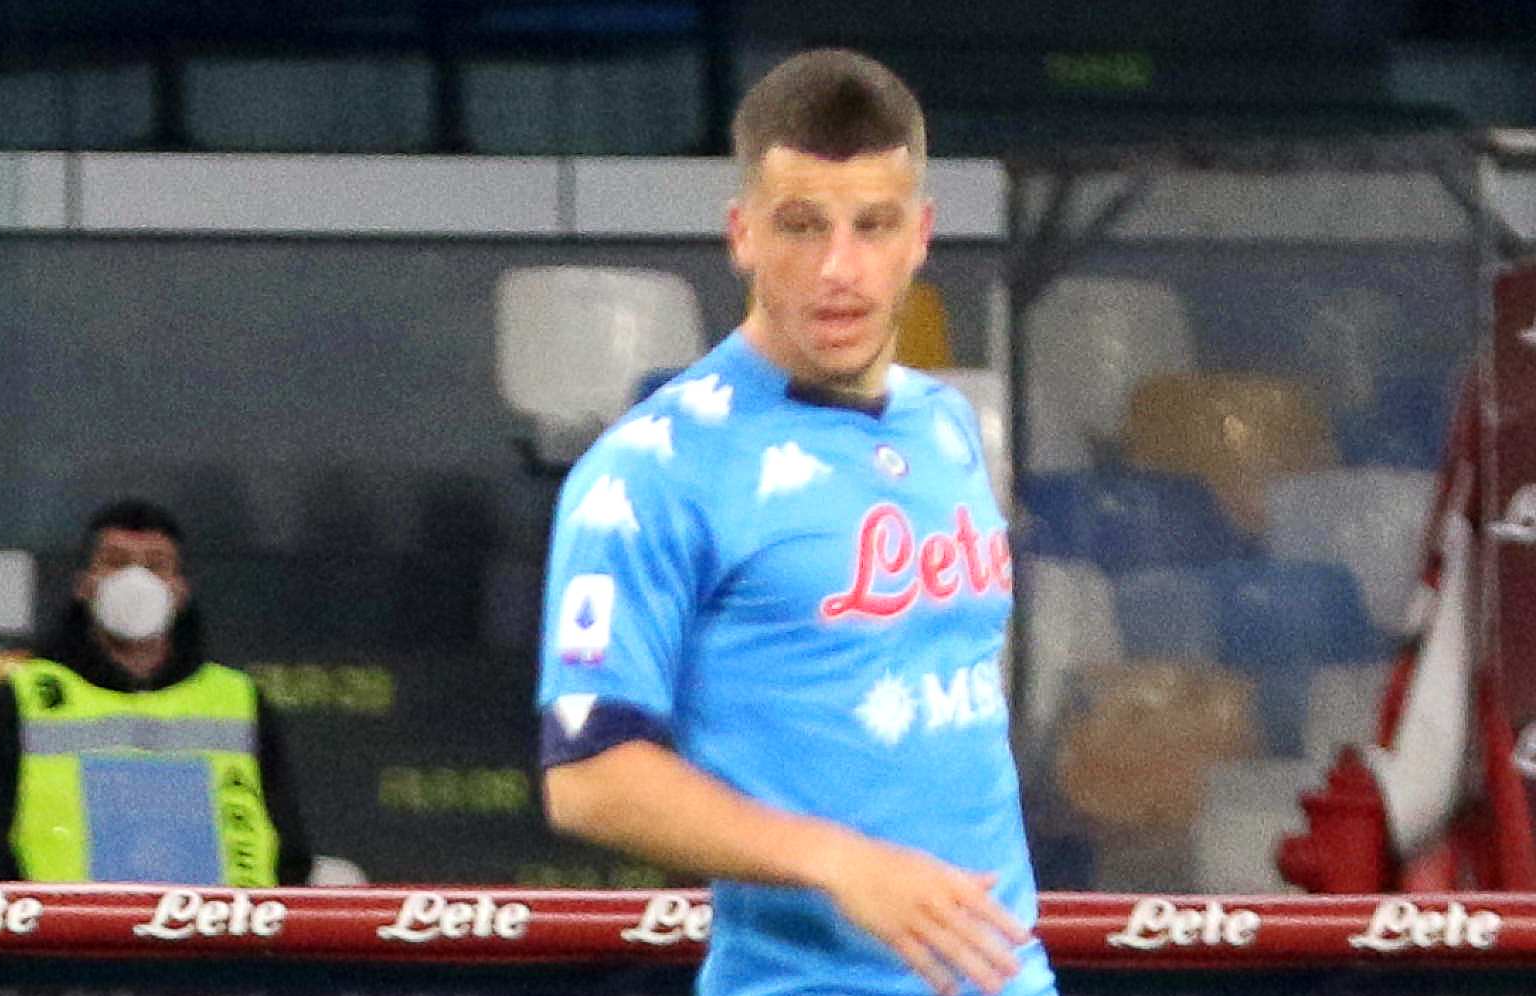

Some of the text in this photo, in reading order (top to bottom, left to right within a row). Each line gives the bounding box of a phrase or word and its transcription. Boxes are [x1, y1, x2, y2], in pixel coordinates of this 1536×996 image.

[134, 888, 288, 940] Lete
[376, 891, 532, 944] Lete
[621, 895, 713, 946] Le
[1108, 900, 1261, 950] Lete
[1350, 901, 1502, 951] Lete
